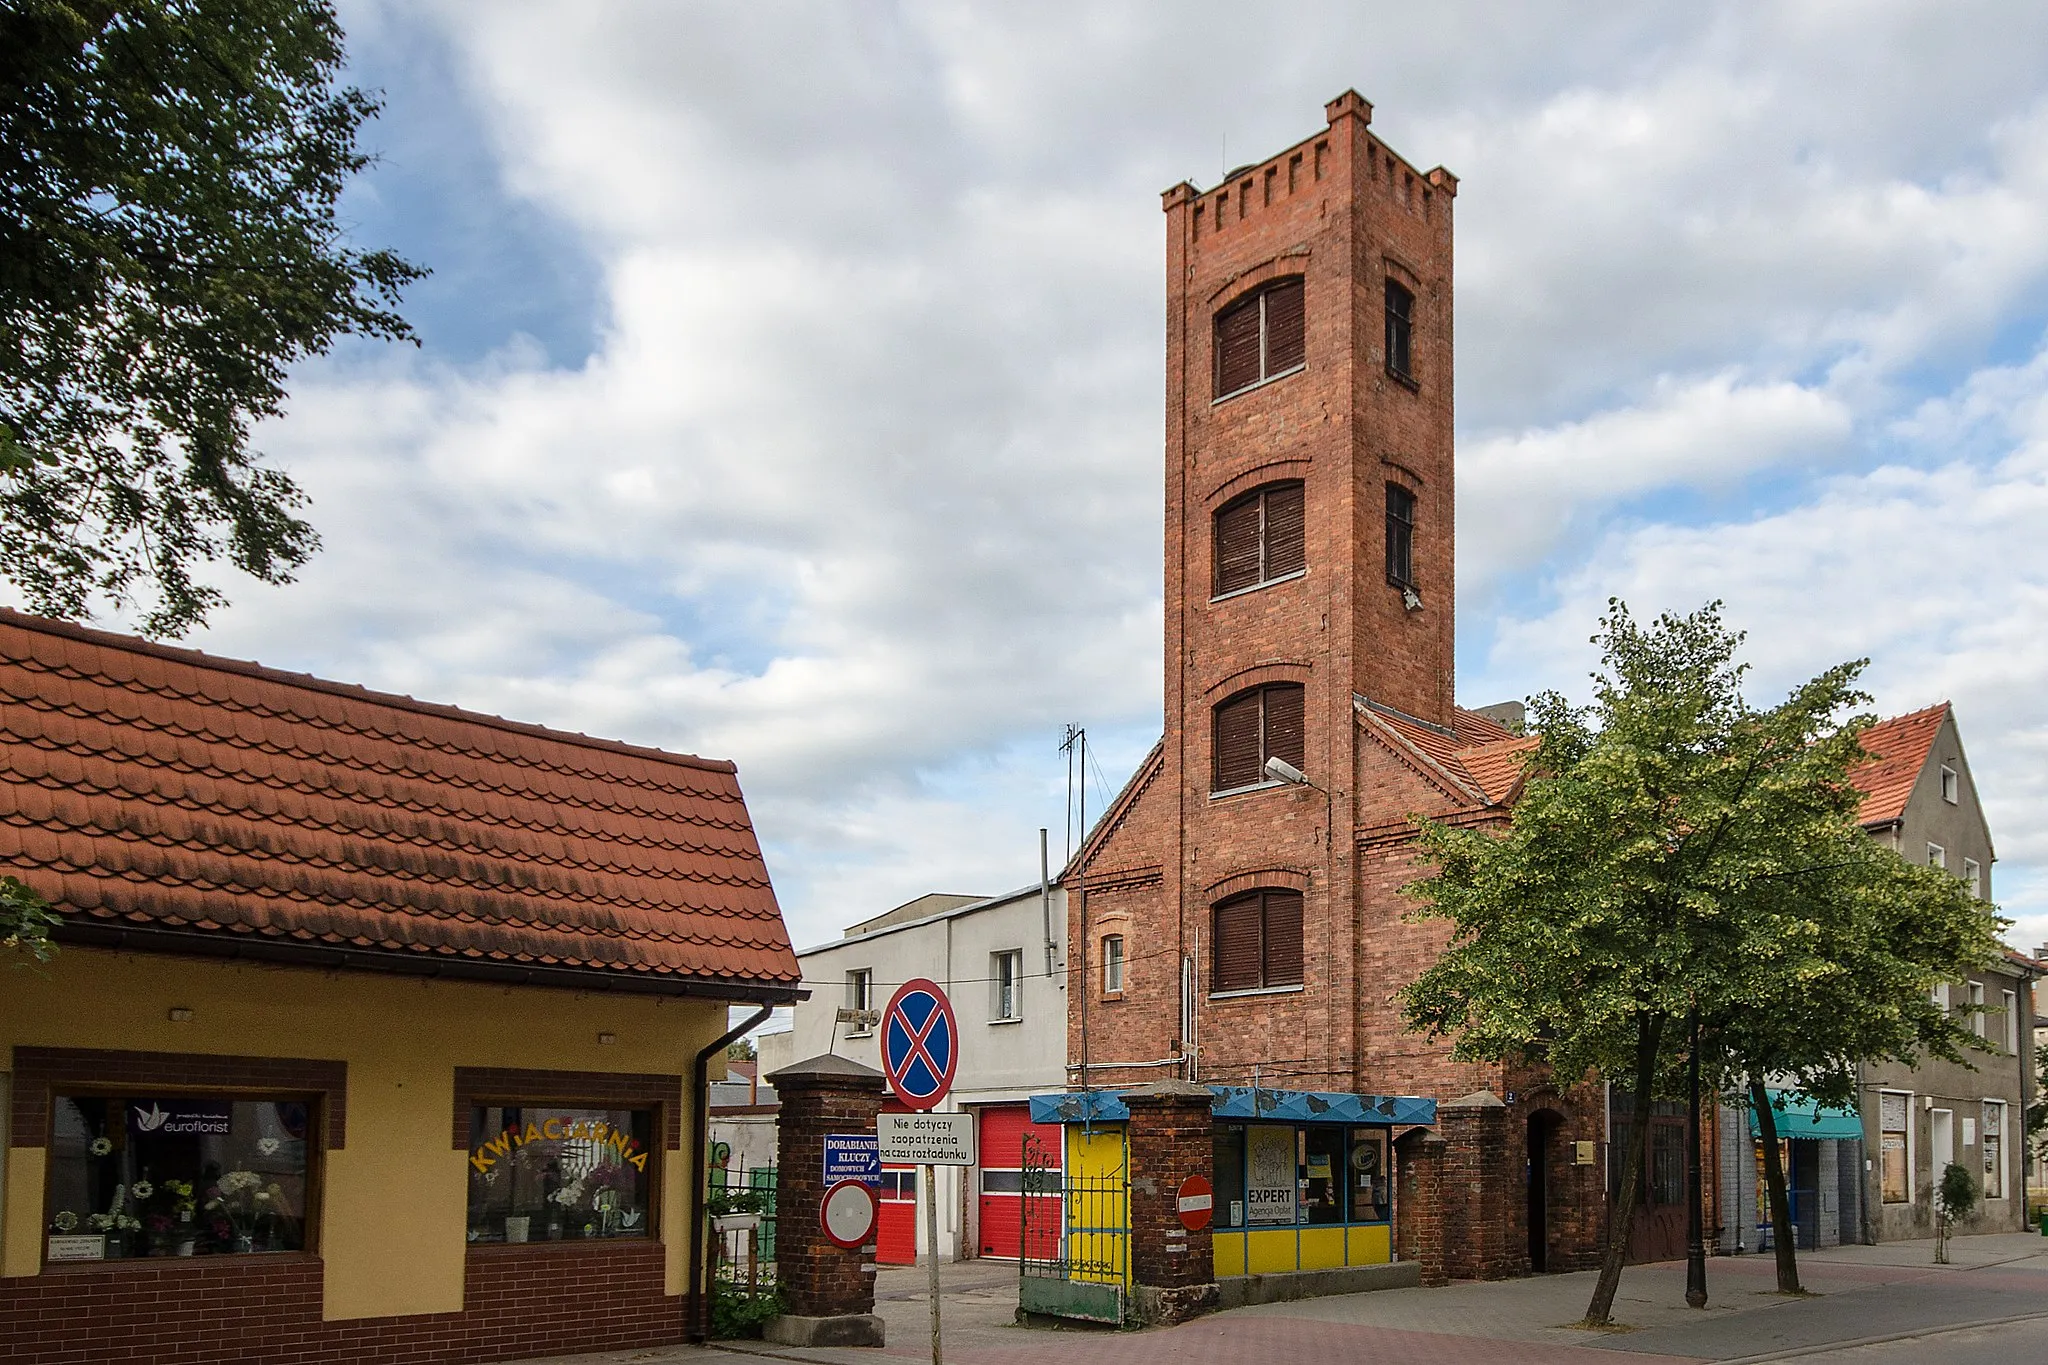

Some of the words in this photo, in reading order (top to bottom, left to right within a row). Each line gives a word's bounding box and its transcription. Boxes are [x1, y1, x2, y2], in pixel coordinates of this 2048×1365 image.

[165, 1121, 228, 1133] euroflorist
[893, 1118, 909, 1129] Nie
[914, 1119, 952, 1132] dotyczy
[827, 1140, 878, 1150] DORABIANIE
[891, 1134, 958, 1146] zaopatrzenia
[838, 1152, 871, 1162] KLUCZY
[880, 1149, 890, 1158] na
[892, 1149, 910, 1158] czas
[912, 1148, 967, 1160] rozładunku
[1248, 1189, 1291, 1203] EXPERT
